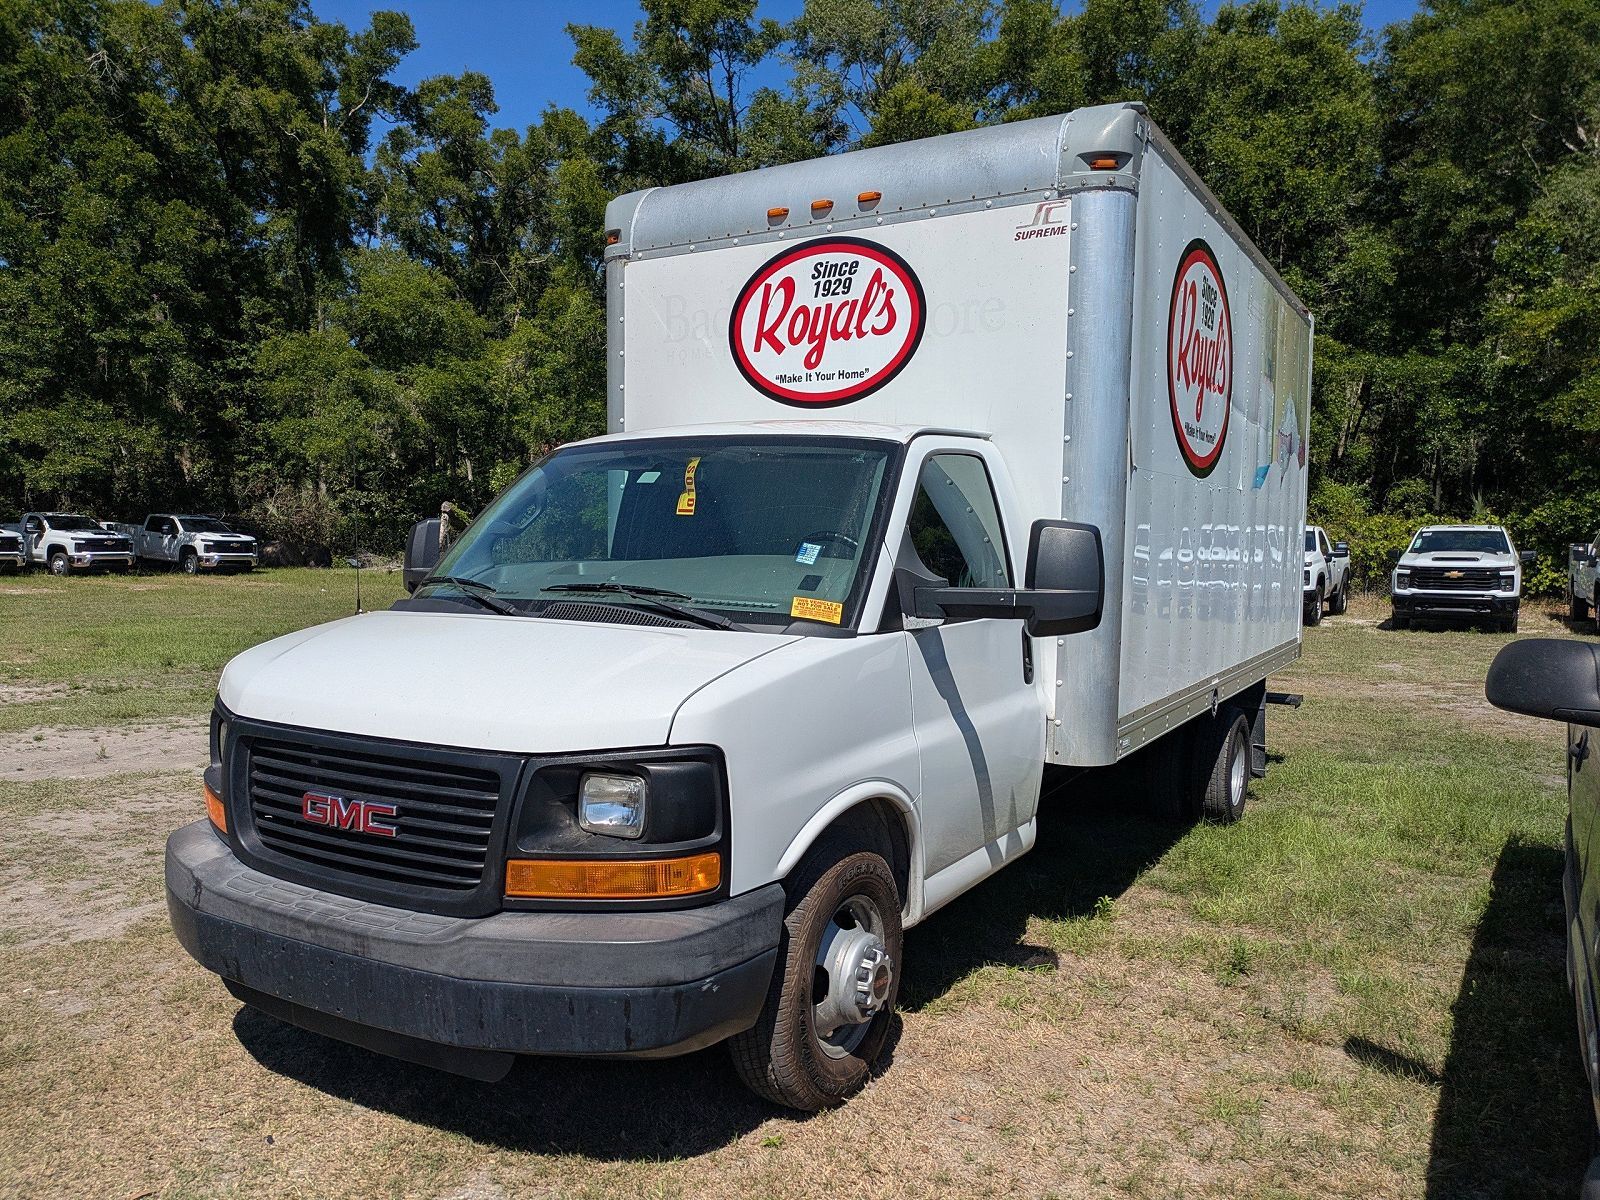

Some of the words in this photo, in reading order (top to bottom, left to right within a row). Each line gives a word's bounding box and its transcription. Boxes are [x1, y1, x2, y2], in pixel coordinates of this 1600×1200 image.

[1014, 225, 1068, 242] SUPREME
[811, 260, 860, 281] Since
[813, 277, 853, 298] 1929
[753, 267, 897, 370] Royal's
[805, 372, 812, 382] It
[815, 371, 836, 382] Your
[685, 465, 695, 507] SOLD
[302, 791, 397, 838] GMC
